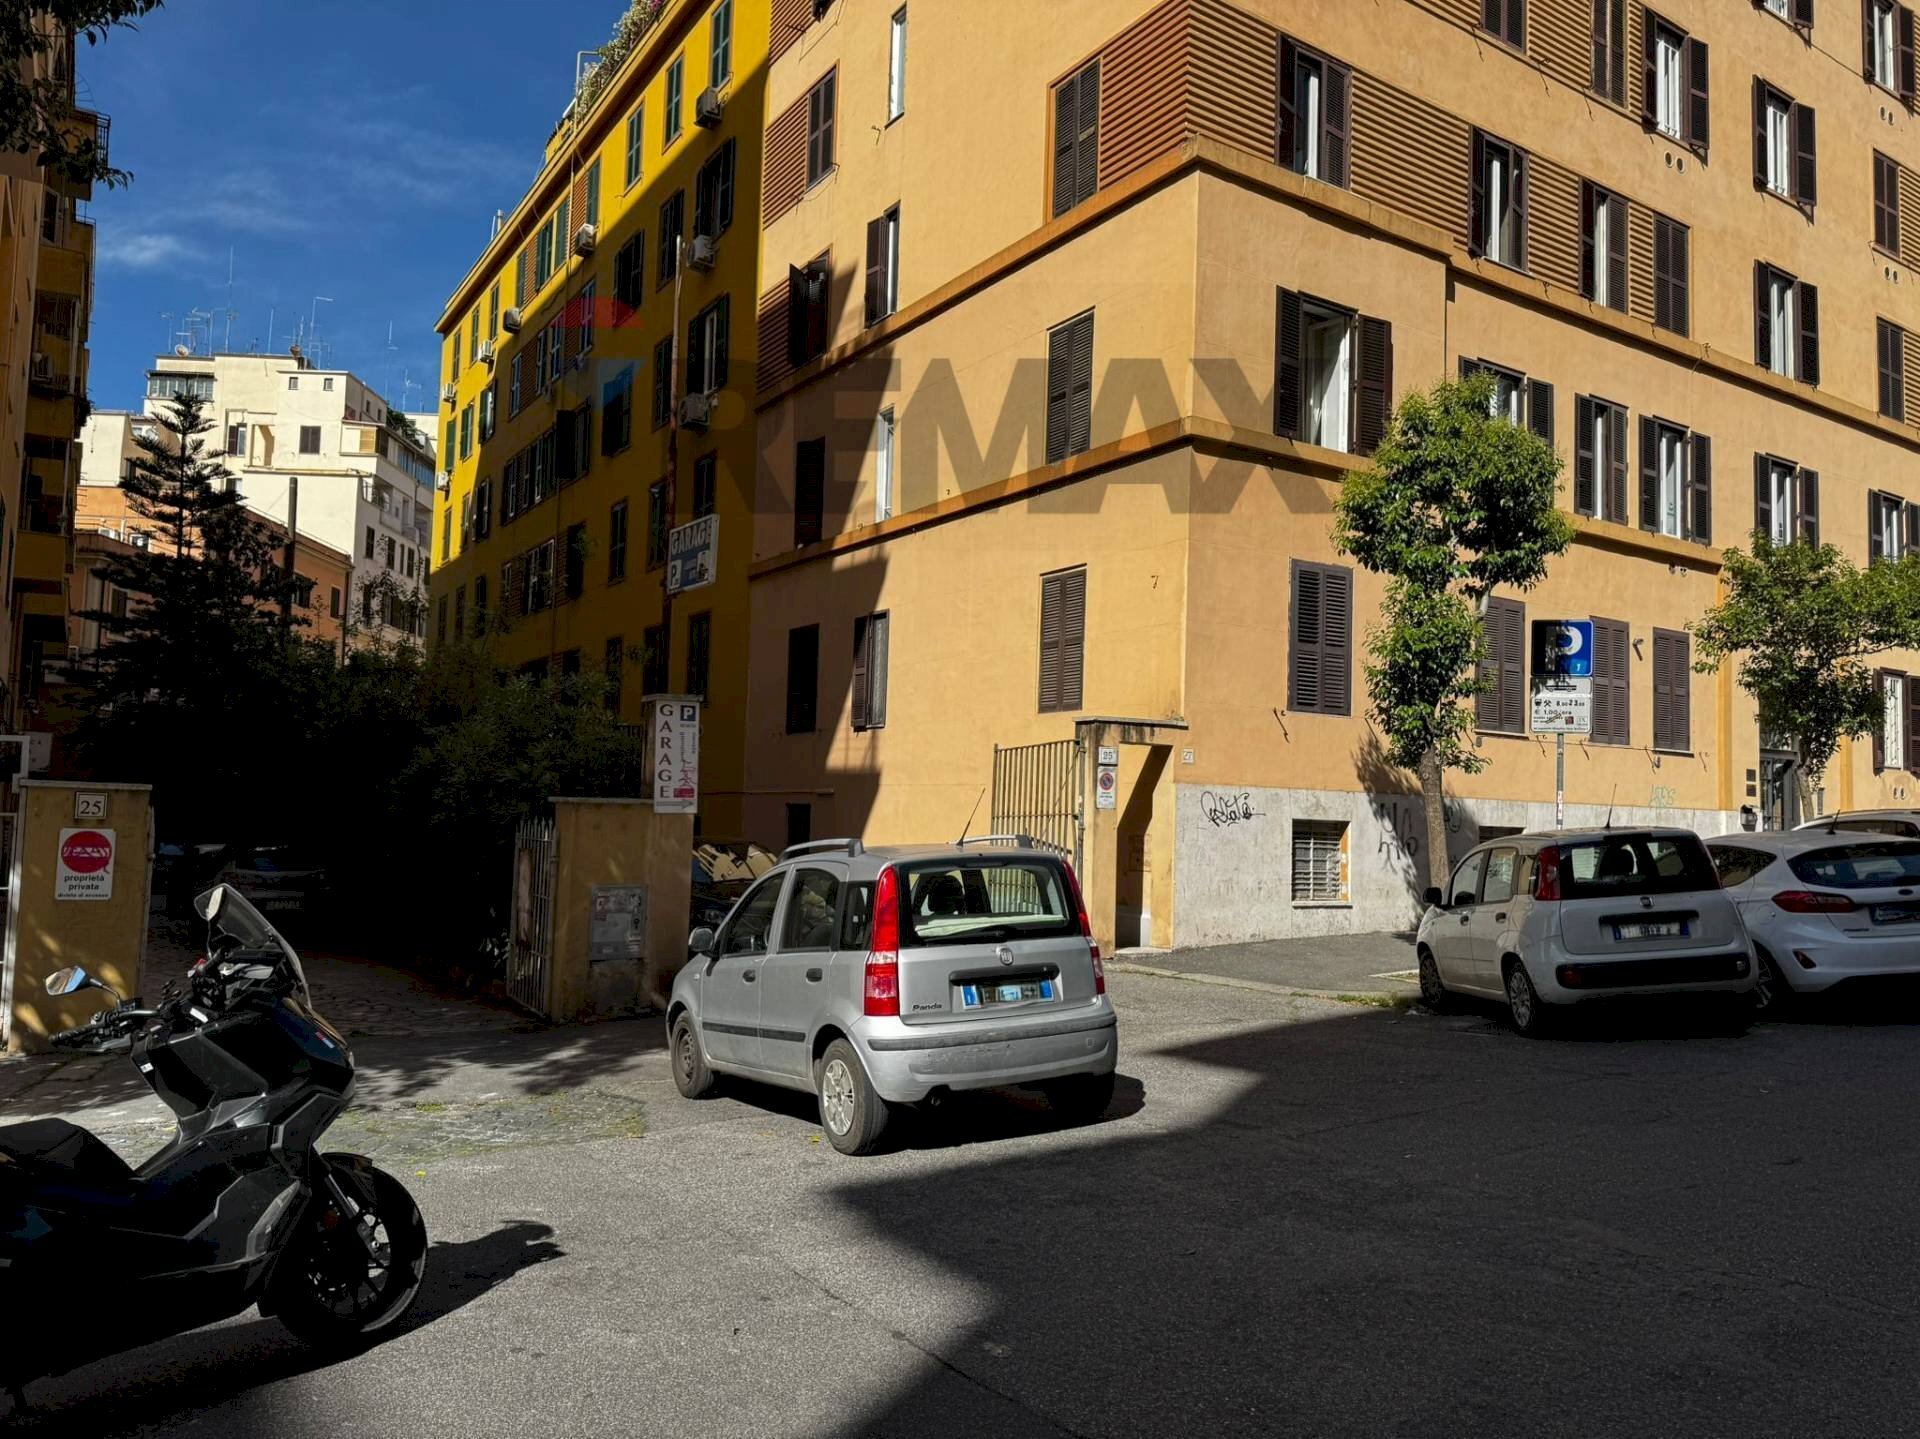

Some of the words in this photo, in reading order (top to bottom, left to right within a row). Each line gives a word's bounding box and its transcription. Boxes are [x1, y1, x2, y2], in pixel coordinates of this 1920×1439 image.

[658, 704, 673, 798] GARAGE
[80, 801, 101, 815] 25
[64, 874, 105, 882] proprietà
[68, 882, 100, 891] privata
[912, 1003, 942, 1012] Panda
